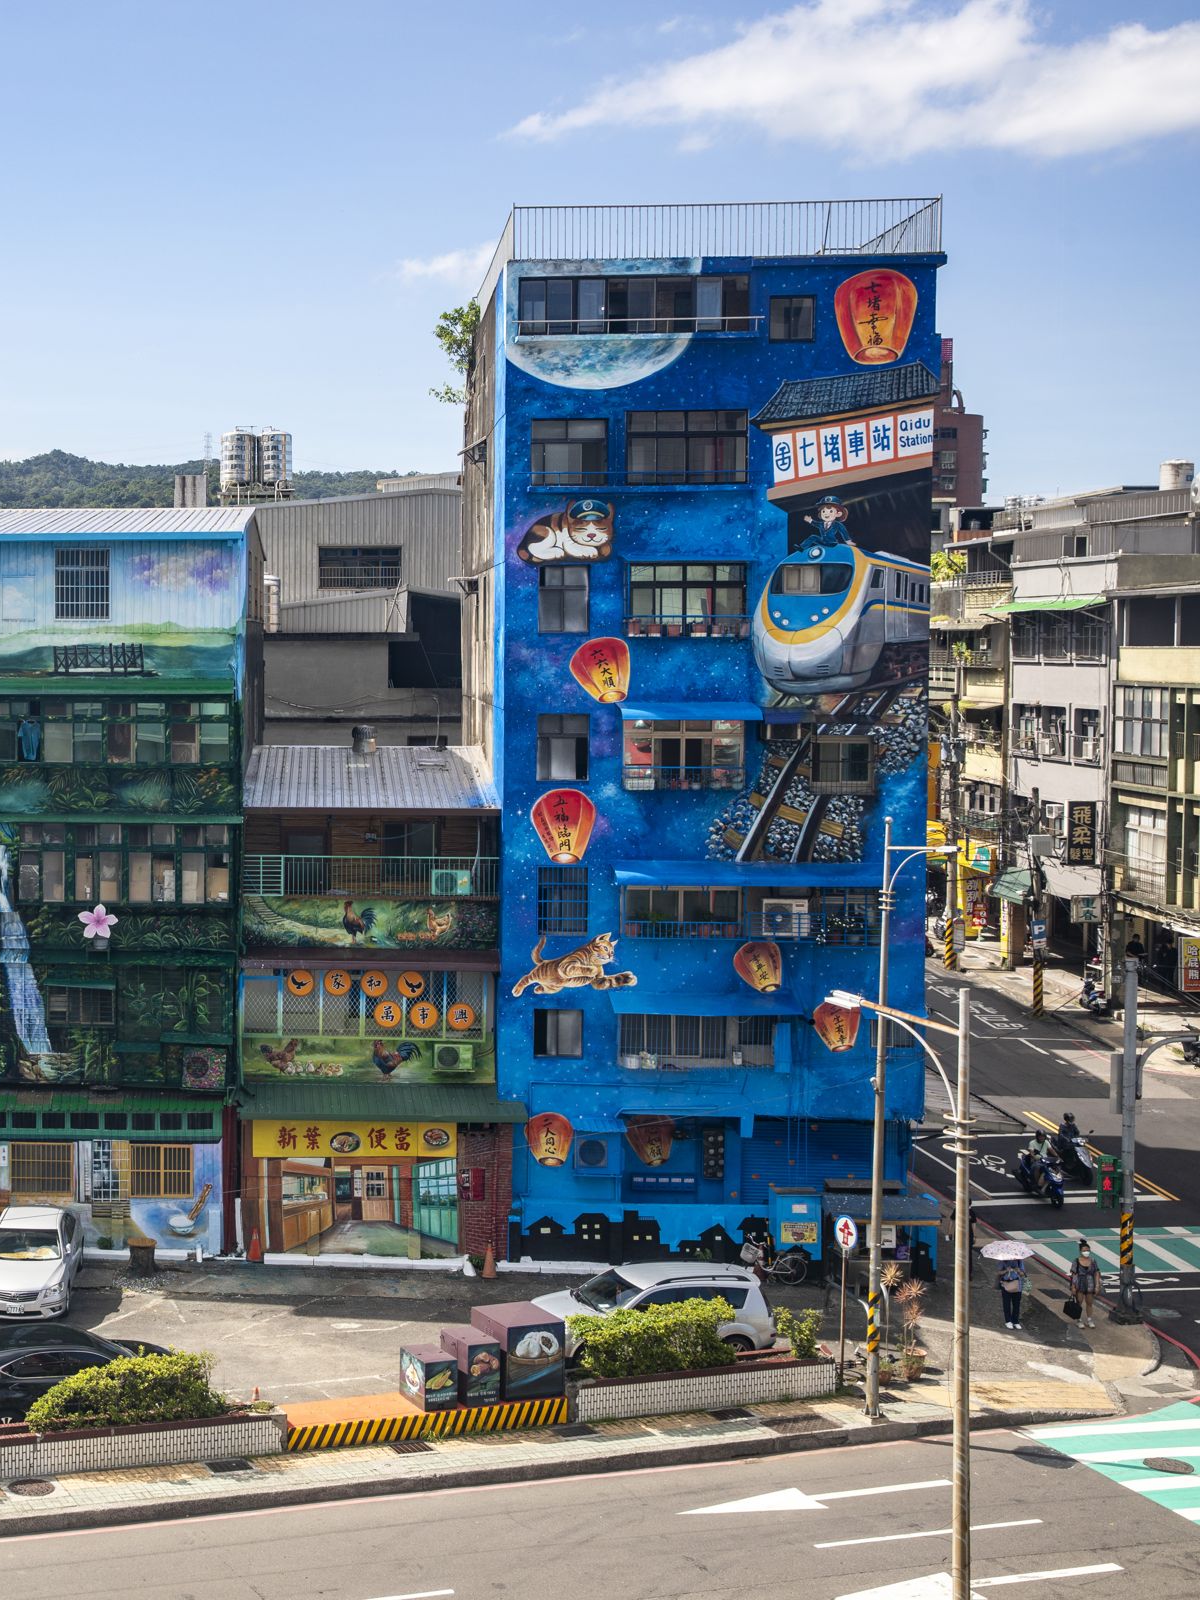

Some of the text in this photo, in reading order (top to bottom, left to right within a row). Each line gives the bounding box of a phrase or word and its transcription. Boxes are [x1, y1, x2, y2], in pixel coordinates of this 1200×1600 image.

[858, 281, 889, 346] 七堵幸福
[899, 418, 931, 432] Qidu
[800, 424, 891, 467] 七堵車站
[899, 434, 933, 448] Station
[590, 649, 617, 689] 六六大順
[553, 794, 572, 852] 五福臨門
[1072, 805, 1092, 845] 飛柔
[1033, 924, 1046, 935] P
[331, 973, 382, 991] 家和
[381, 1005, 469, 1024] 萬事興
[277, 1126, 411, 1151] 新葉 便當
[543, 1118, 557, 1155] 二人同心
